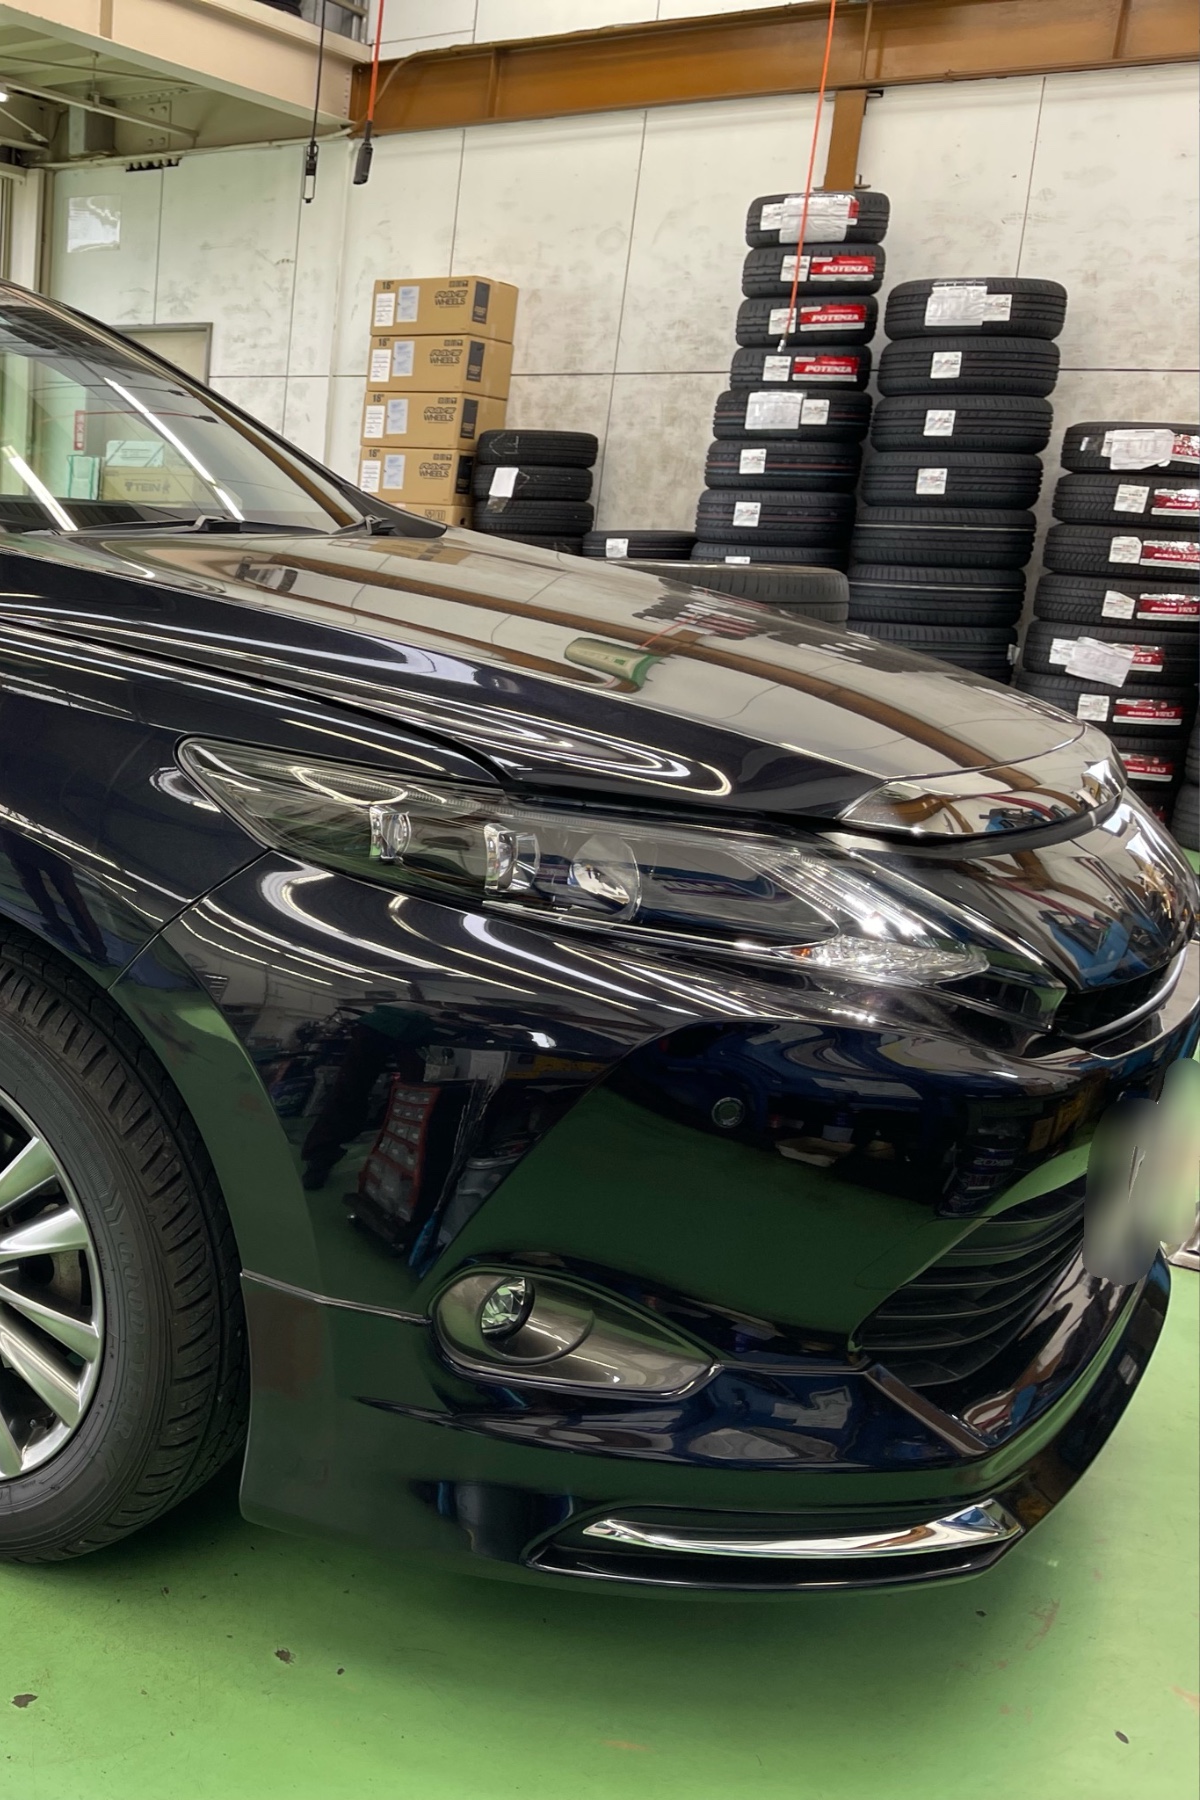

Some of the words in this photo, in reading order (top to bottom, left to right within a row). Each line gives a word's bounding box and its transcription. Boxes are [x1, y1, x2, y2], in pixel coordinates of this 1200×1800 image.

[435, 298, 465, 306] WHEELS
[811, 314, 859, 322] POTENZA
[429, 356, 460, 364] WHEELS
[804, 364, 852, 373] POTENZA
[423, 413, 454, 422] WHEELS
[419, 469, 449, 478] WHEELS
[135, 482, 160, 492] TEIN
